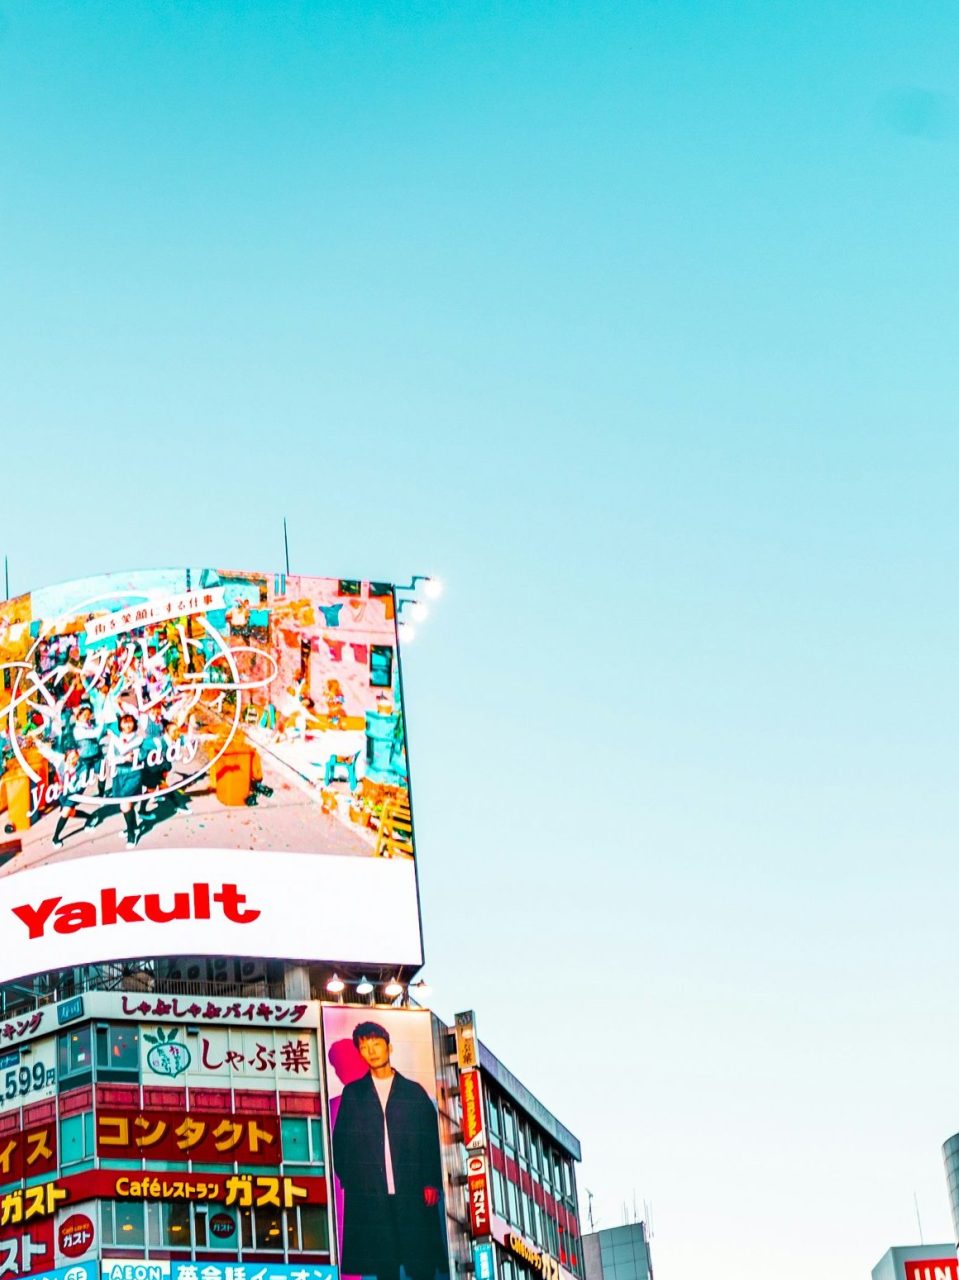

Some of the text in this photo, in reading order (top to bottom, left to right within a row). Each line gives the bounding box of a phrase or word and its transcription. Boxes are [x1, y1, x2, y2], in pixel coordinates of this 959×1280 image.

[12, 883, 262, 940] Yakult
[121, 996, 308, 1023] しゃぶしゃぶバイキング
[202, 1038, 311, 1075] しゃぶ葉
[98, 1116, 274, 1153] コンタクト
[1, 1183, 67, 1226] ガスト
[225, 1175, 308, 1208] ガスト
[473, 1190, 487, 1228] ガスト
[63, 1231, 91, 1248] ガスト
